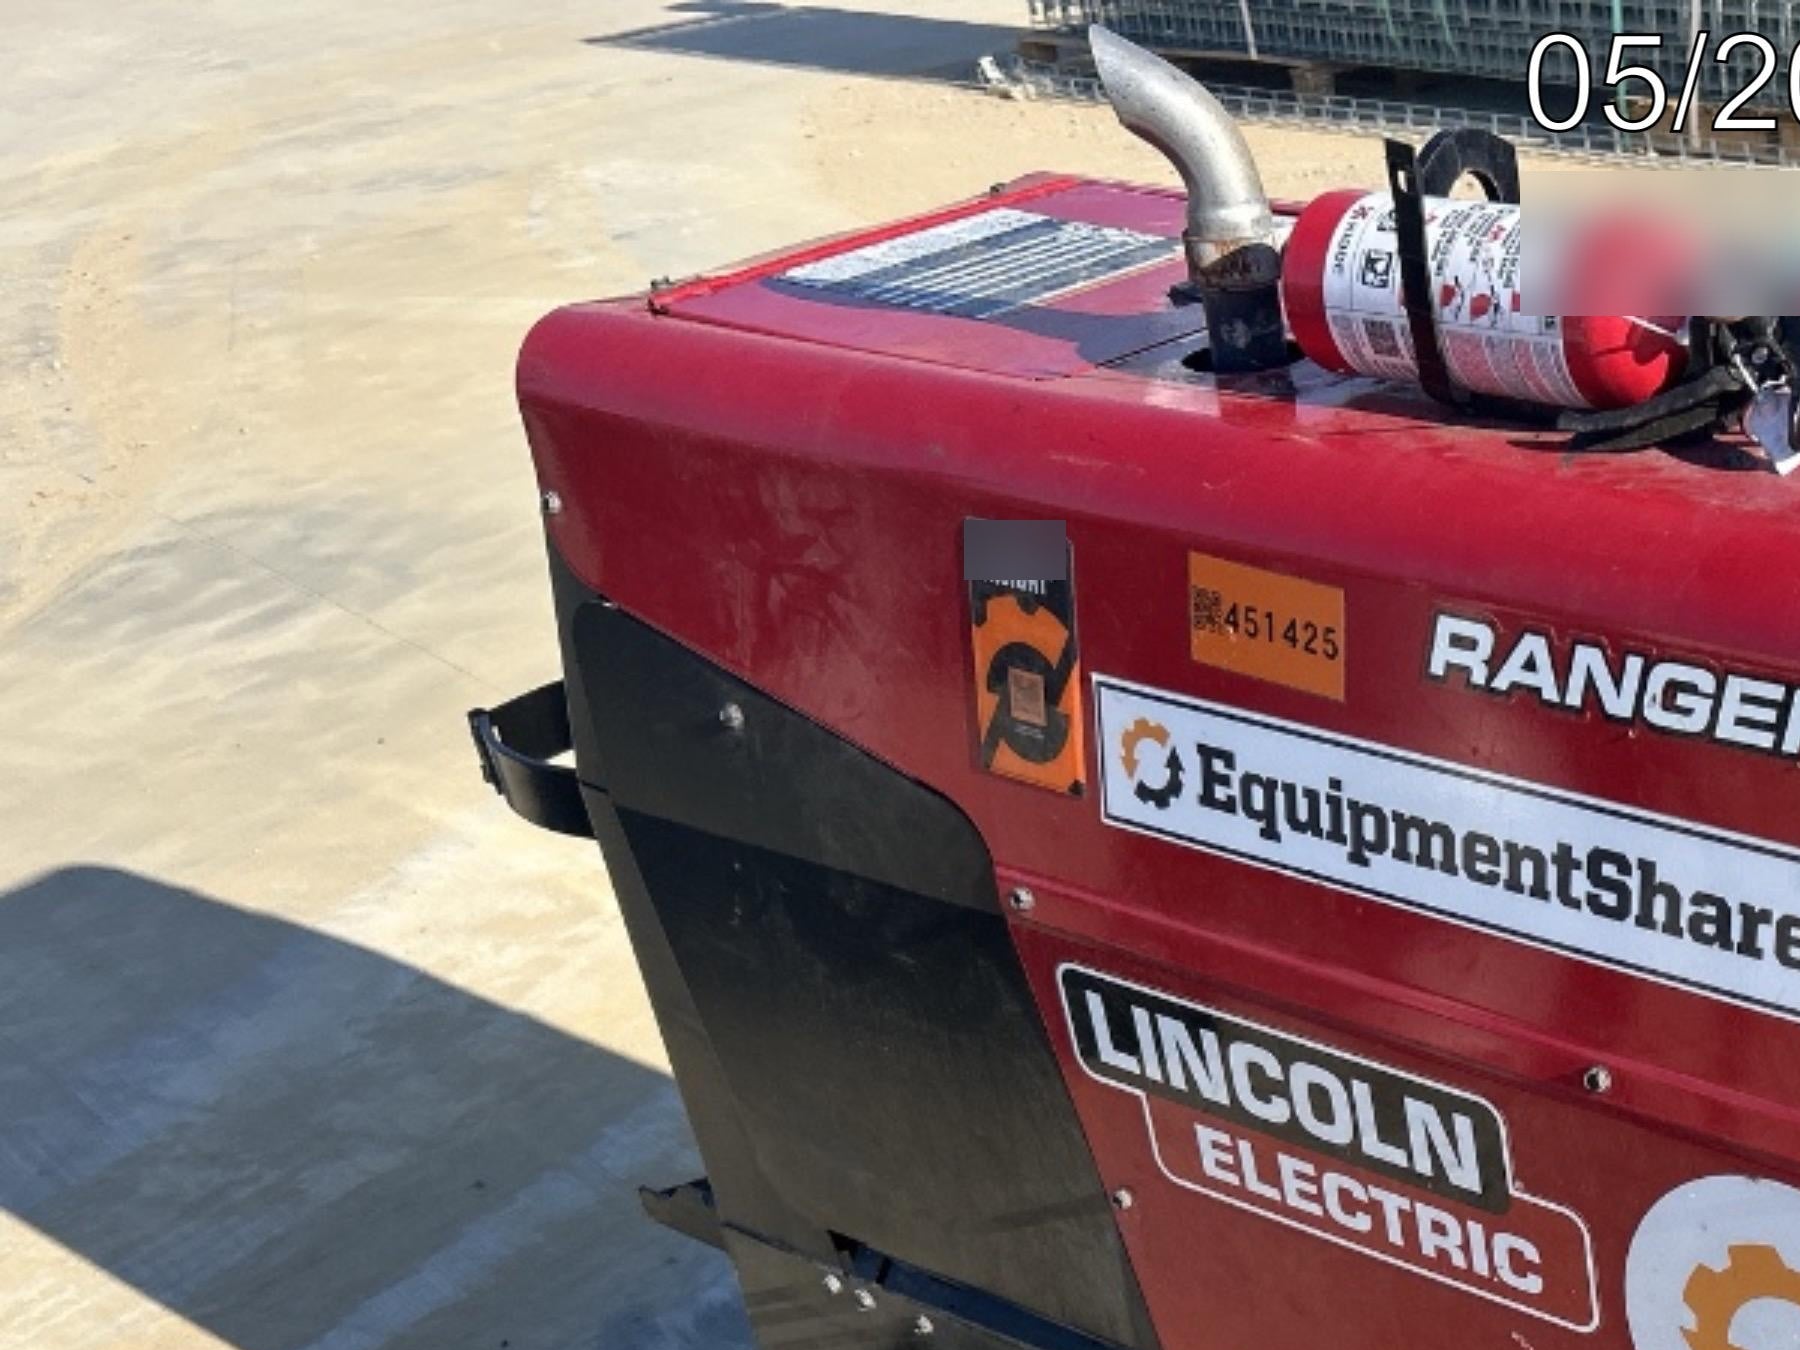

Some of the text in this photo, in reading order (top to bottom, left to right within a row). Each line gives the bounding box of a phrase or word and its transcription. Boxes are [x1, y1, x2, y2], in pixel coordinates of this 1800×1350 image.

[1223, 602, 1340, 661] 451425
[1084, 989, 1482, 1195] LINCOLN
[1194, 1122, 1544, 1294] ELECTRIC
